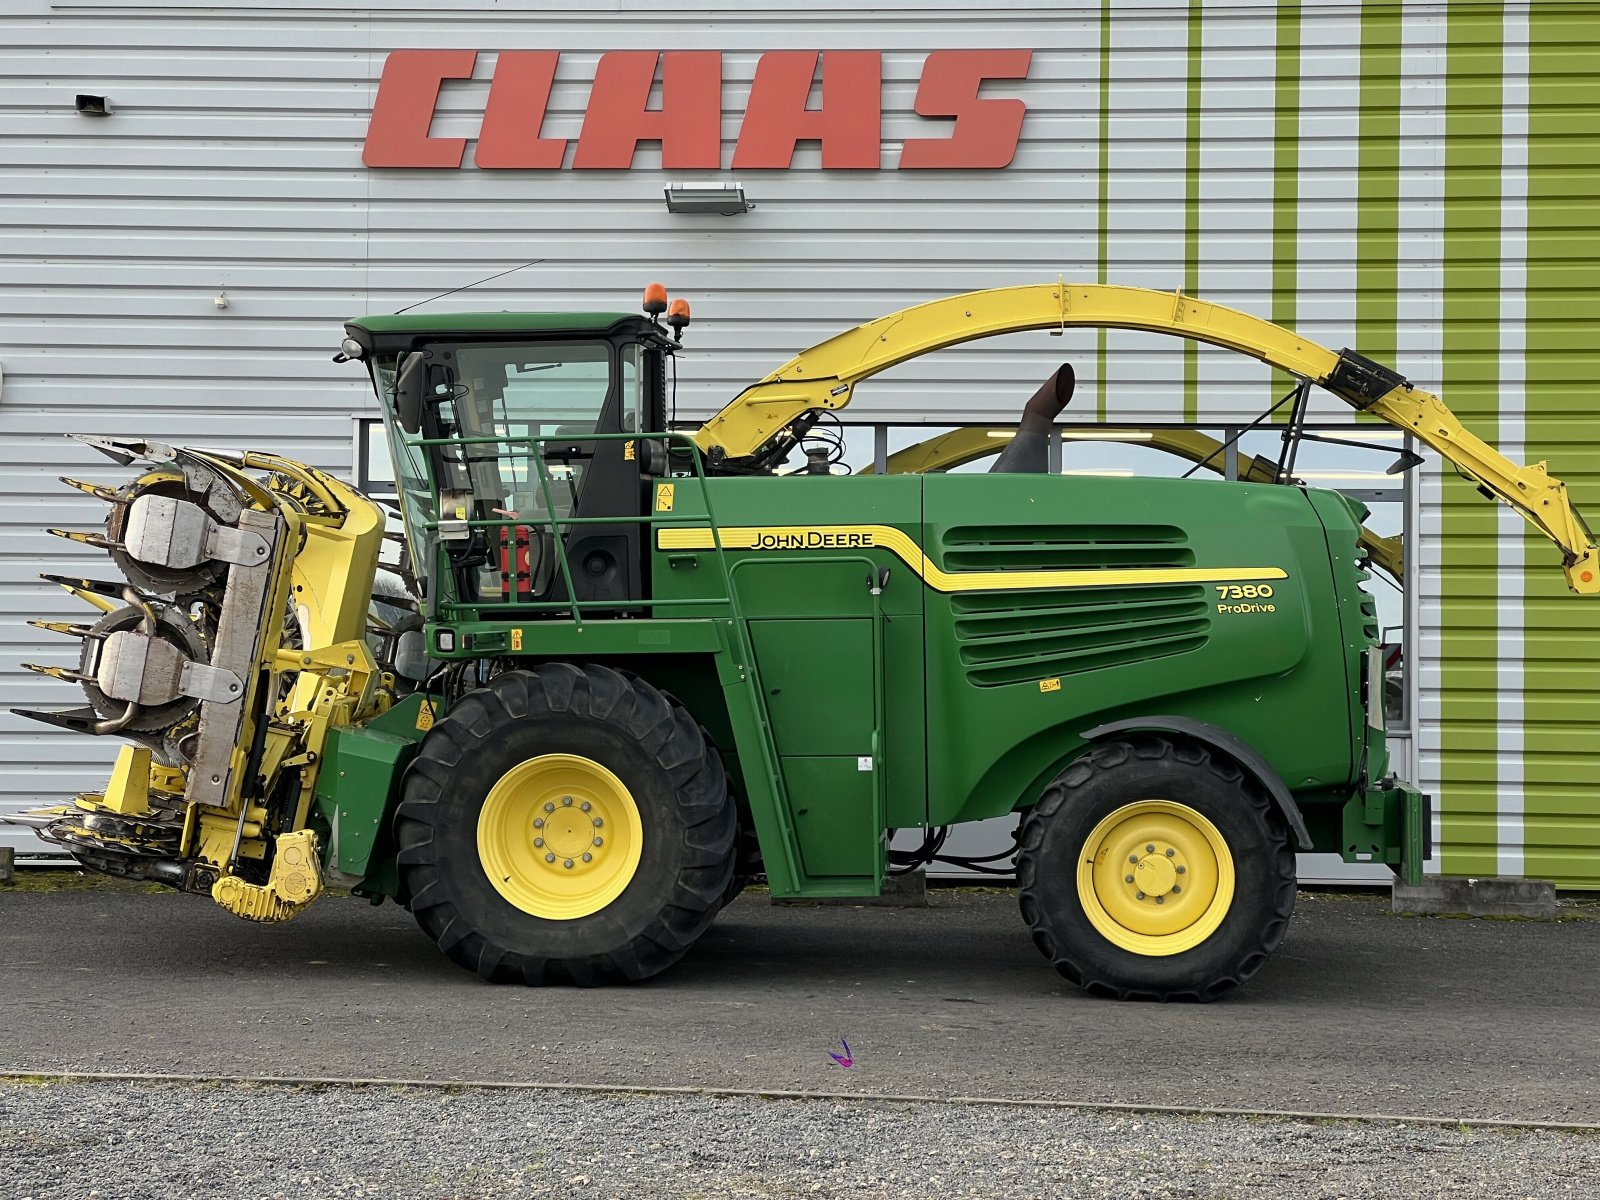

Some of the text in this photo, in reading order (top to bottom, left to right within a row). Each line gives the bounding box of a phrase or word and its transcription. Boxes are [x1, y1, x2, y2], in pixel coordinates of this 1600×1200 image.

[362, 50, 1033, 170] CLAAS
[751, 531, 873, 547] JOHN DEERE
[1215, 584, 1274, 600] 7380
[1217, 602, 1276, 614] ProDrive
